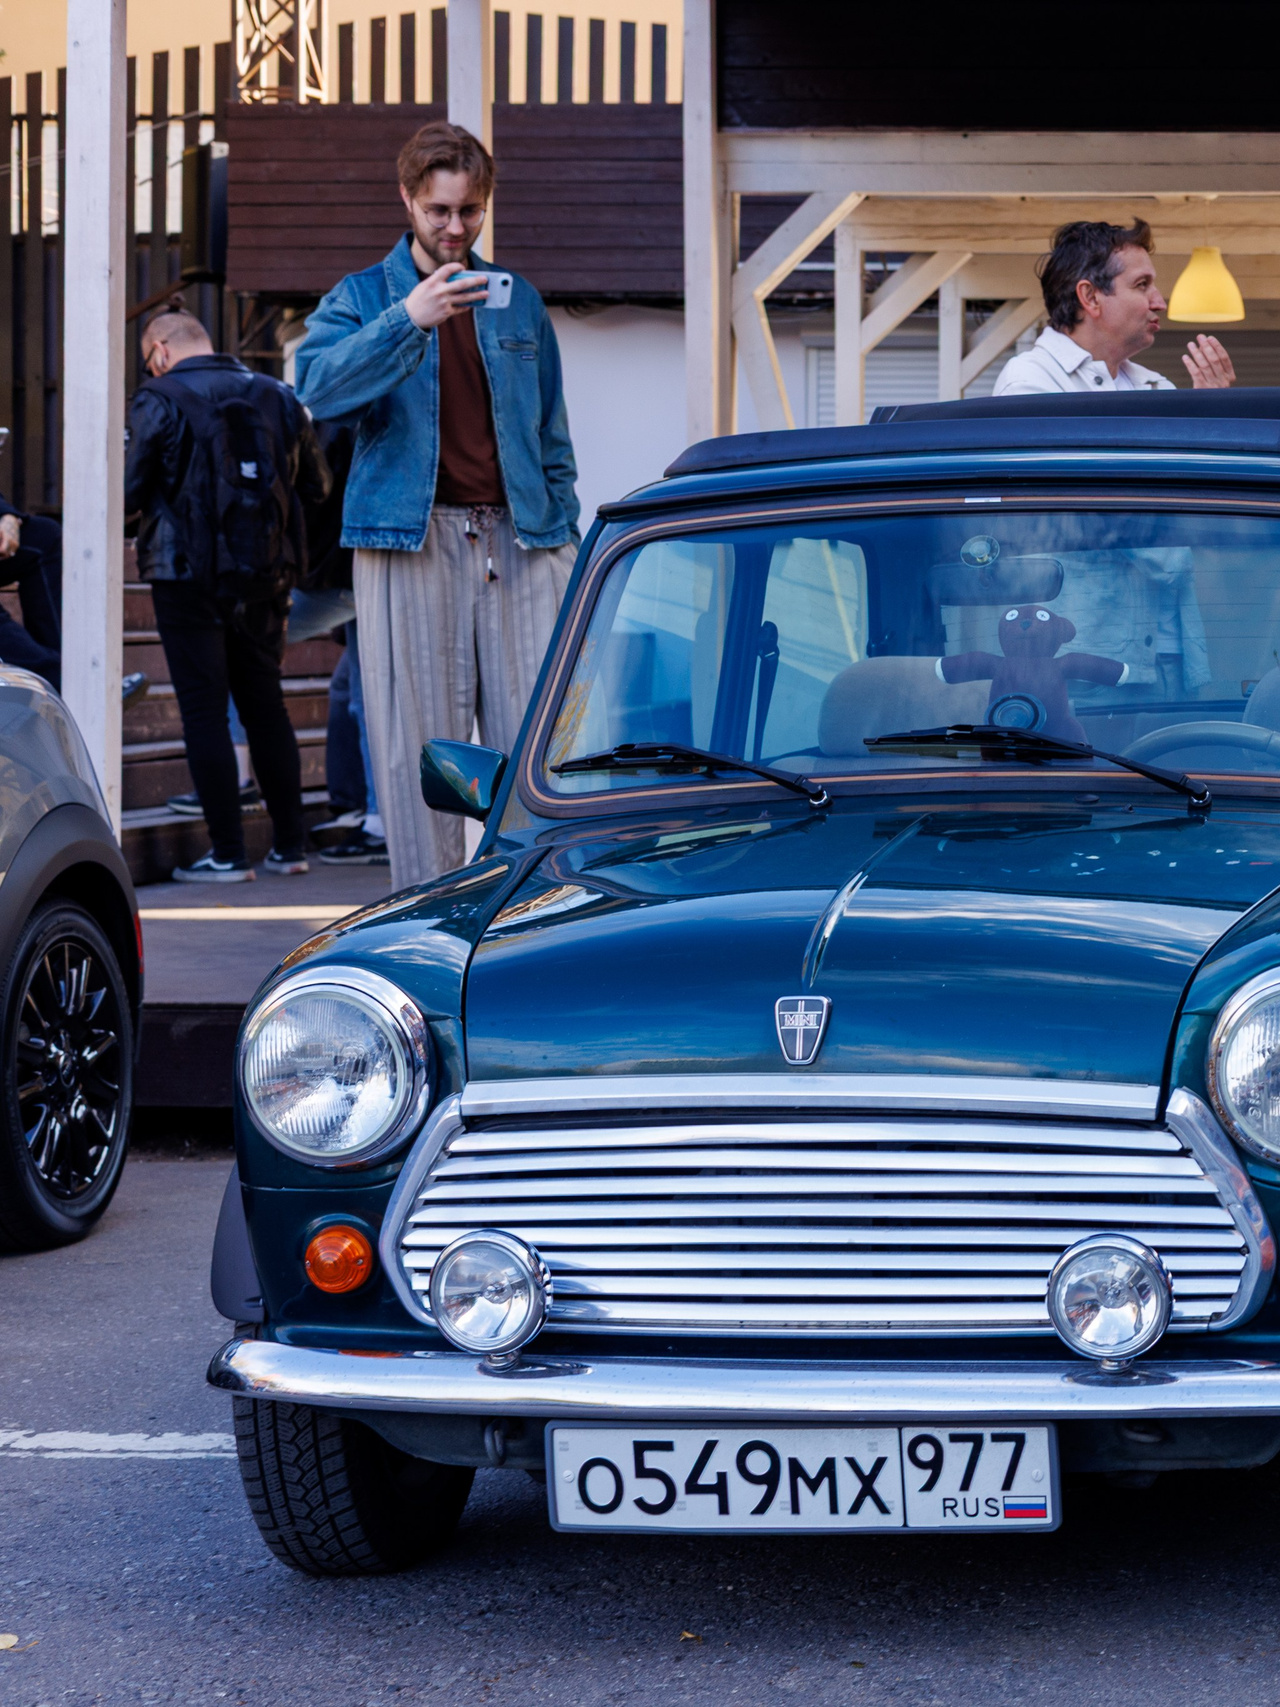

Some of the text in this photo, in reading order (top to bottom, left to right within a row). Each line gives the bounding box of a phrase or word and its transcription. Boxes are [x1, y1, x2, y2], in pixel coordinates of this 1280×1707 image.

[784, 1014, 818, 1027] MINI
[907, 1432, 1026, 1493] 977
[942, 1496, 1000, 1518] RUS
